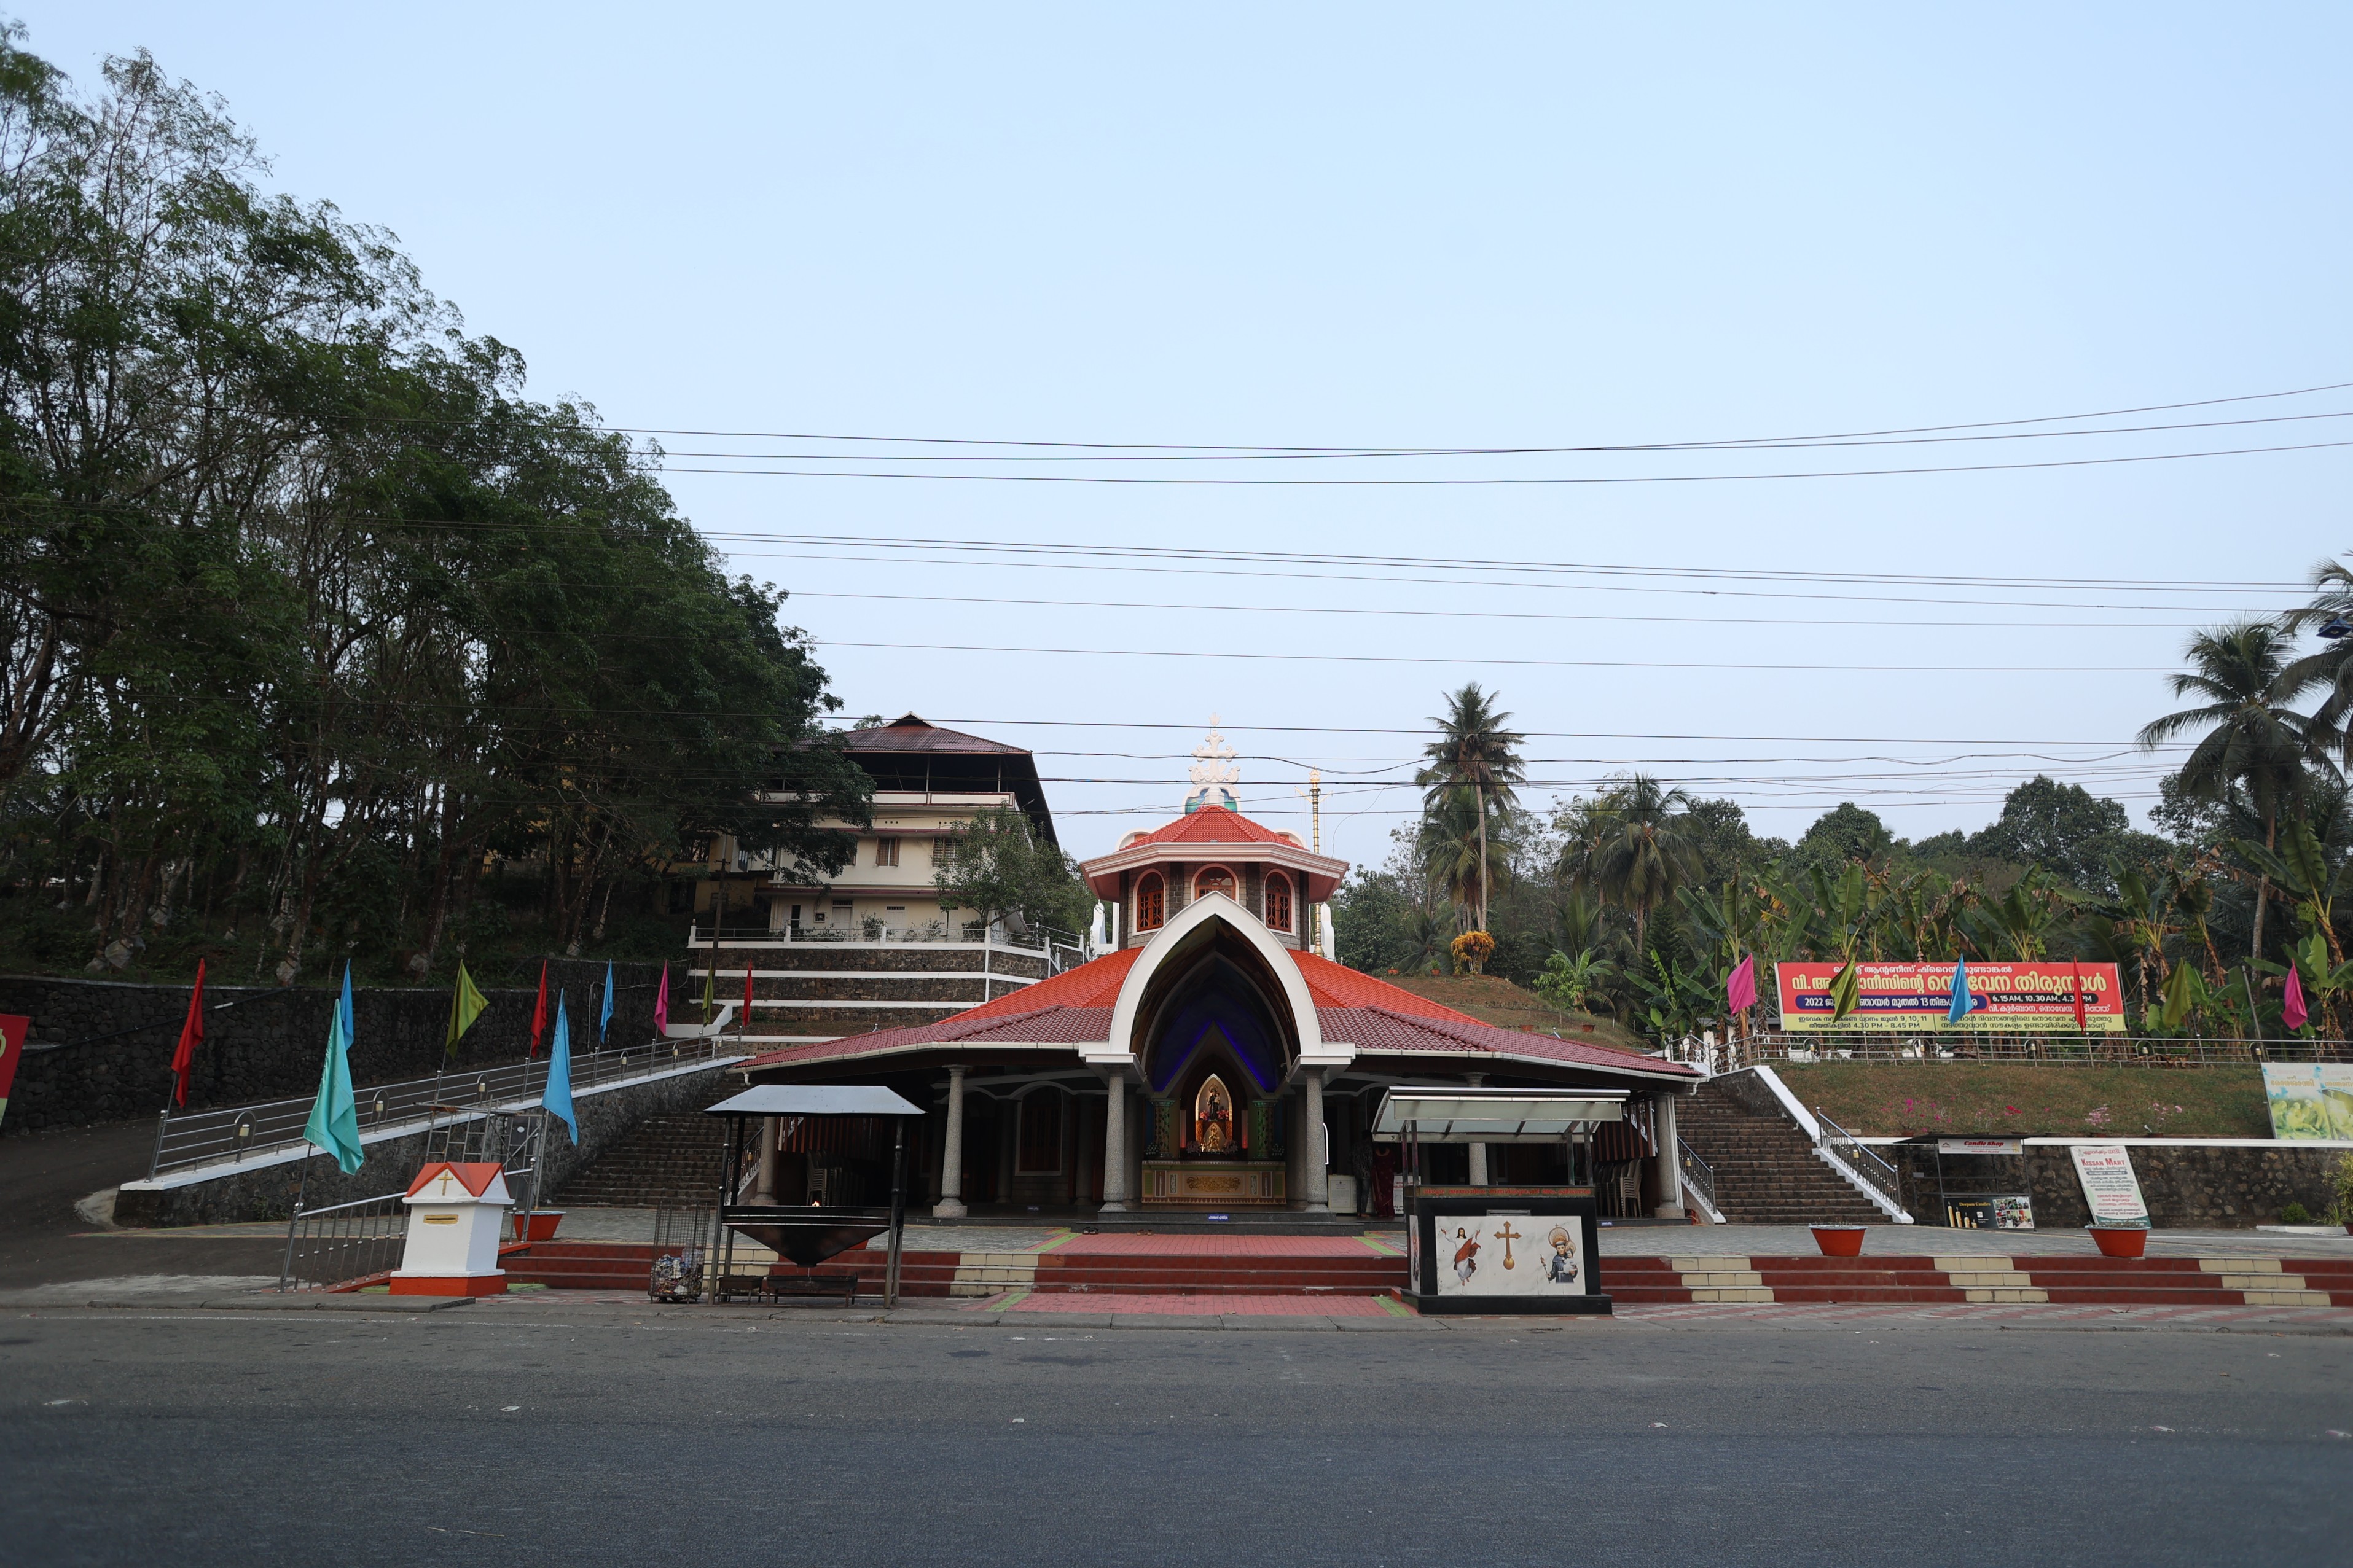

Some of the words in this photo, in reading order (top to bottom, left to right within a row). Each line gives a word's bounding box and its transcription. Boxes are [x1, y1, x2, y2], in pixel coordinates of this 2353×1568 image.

[1804, 997, 1823, 1007] 2022
[1892, 997, 1919, 1008] മുതൽ
[1920, 998, 1928, 1007] 13
